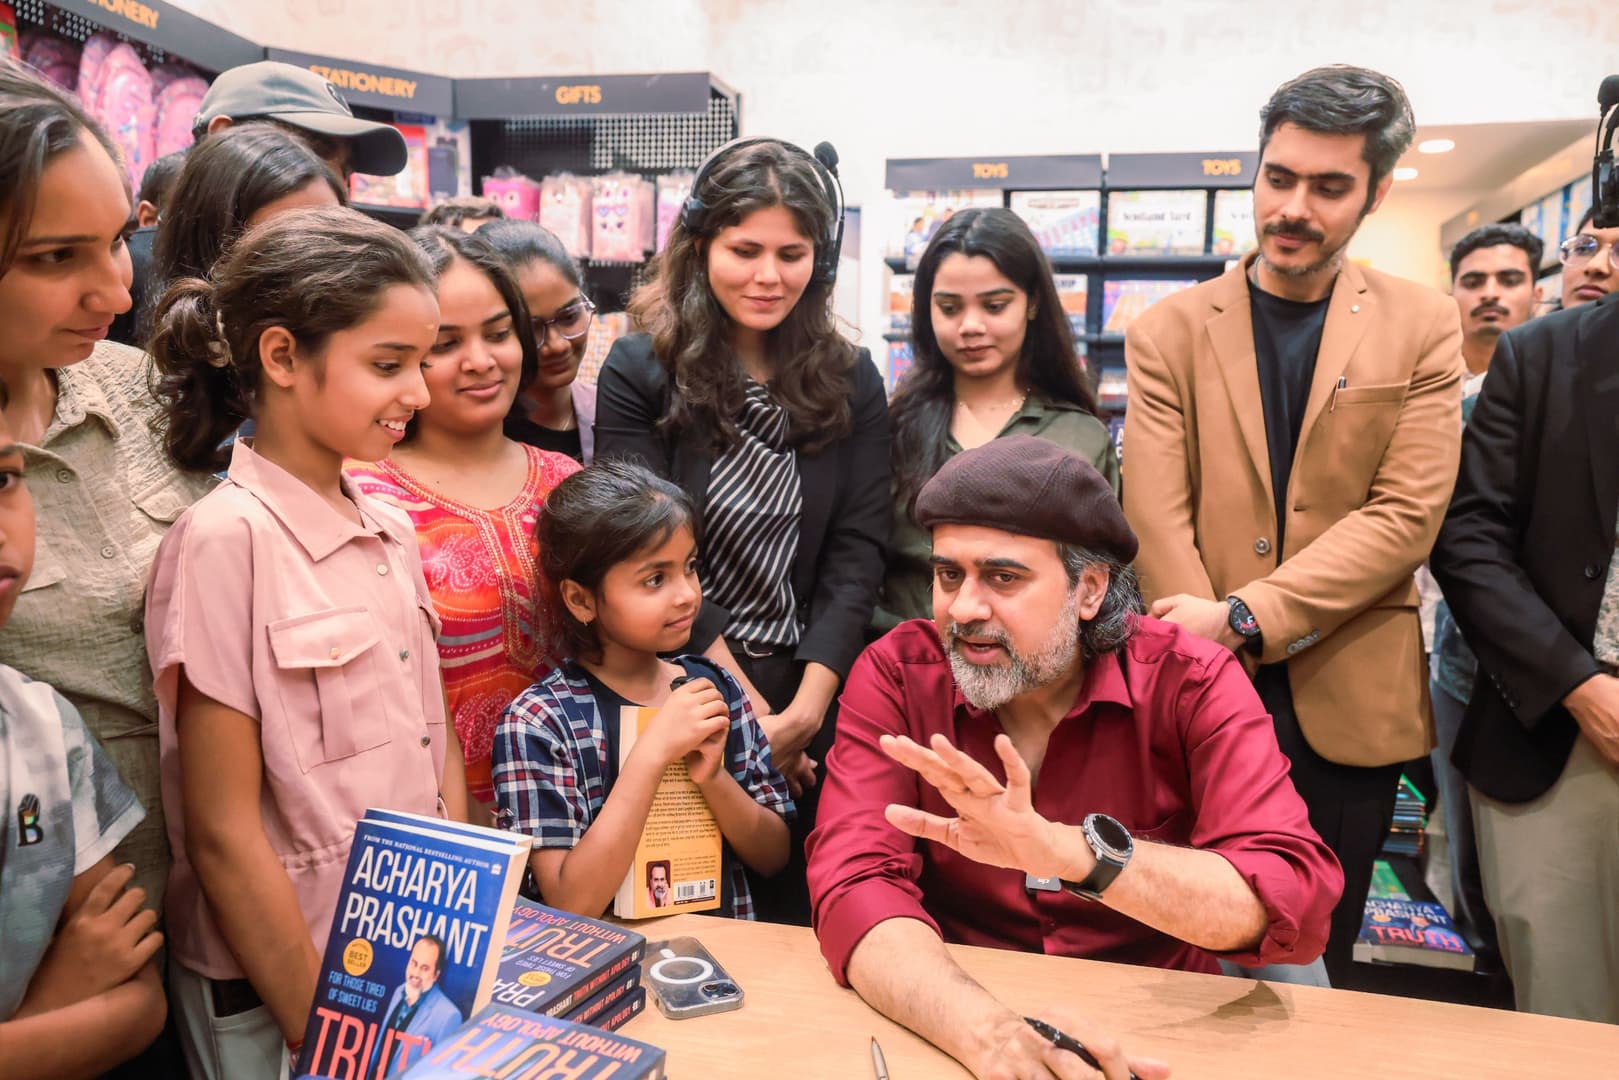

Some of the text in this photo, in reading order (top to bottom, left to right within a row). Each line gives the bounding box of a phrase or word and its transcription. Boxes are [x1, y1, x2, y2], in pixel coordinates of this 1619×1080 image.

[86, 0, 159, 29] ONERY
[555, 85, 602, 104] GIFTS
[973, 163, 1008, 178] TOYS
[1202, 159, 1241, 175] TOYS
[364, 834, 489, 869] FROM THE NATIONAL BESTSELLING AUTHOR
[352, 845, 478, 914] ACHARYA
[340, 892, 489, 968] PRASHANT
[513, 905, 627, 944] WITHOUT APOLOGY
[505, 919, 611, 968] TRUT
[1369, 925, 1463, 951] TRUTH
[348, 950, 368, 961] BEST
[515, 960, 537, 968] TIRED
[540, 959, 567, 970] SWEET
[533, 964, 557, 974] THOSE
[555, 970, 572, 980] FOR
[328, 970, 386, 998] FOR THOSE TIRED
[605, 985, 625, 1005] APOLOGY
[328, 988, 378, 1013] OF SWEET LIES
[611, 1006, 632, 1027] APOLOGY
[309, 1006, 432, 1080] TRUT
[480, 1013, 643, 1064] WITHOUT APOLOGY
